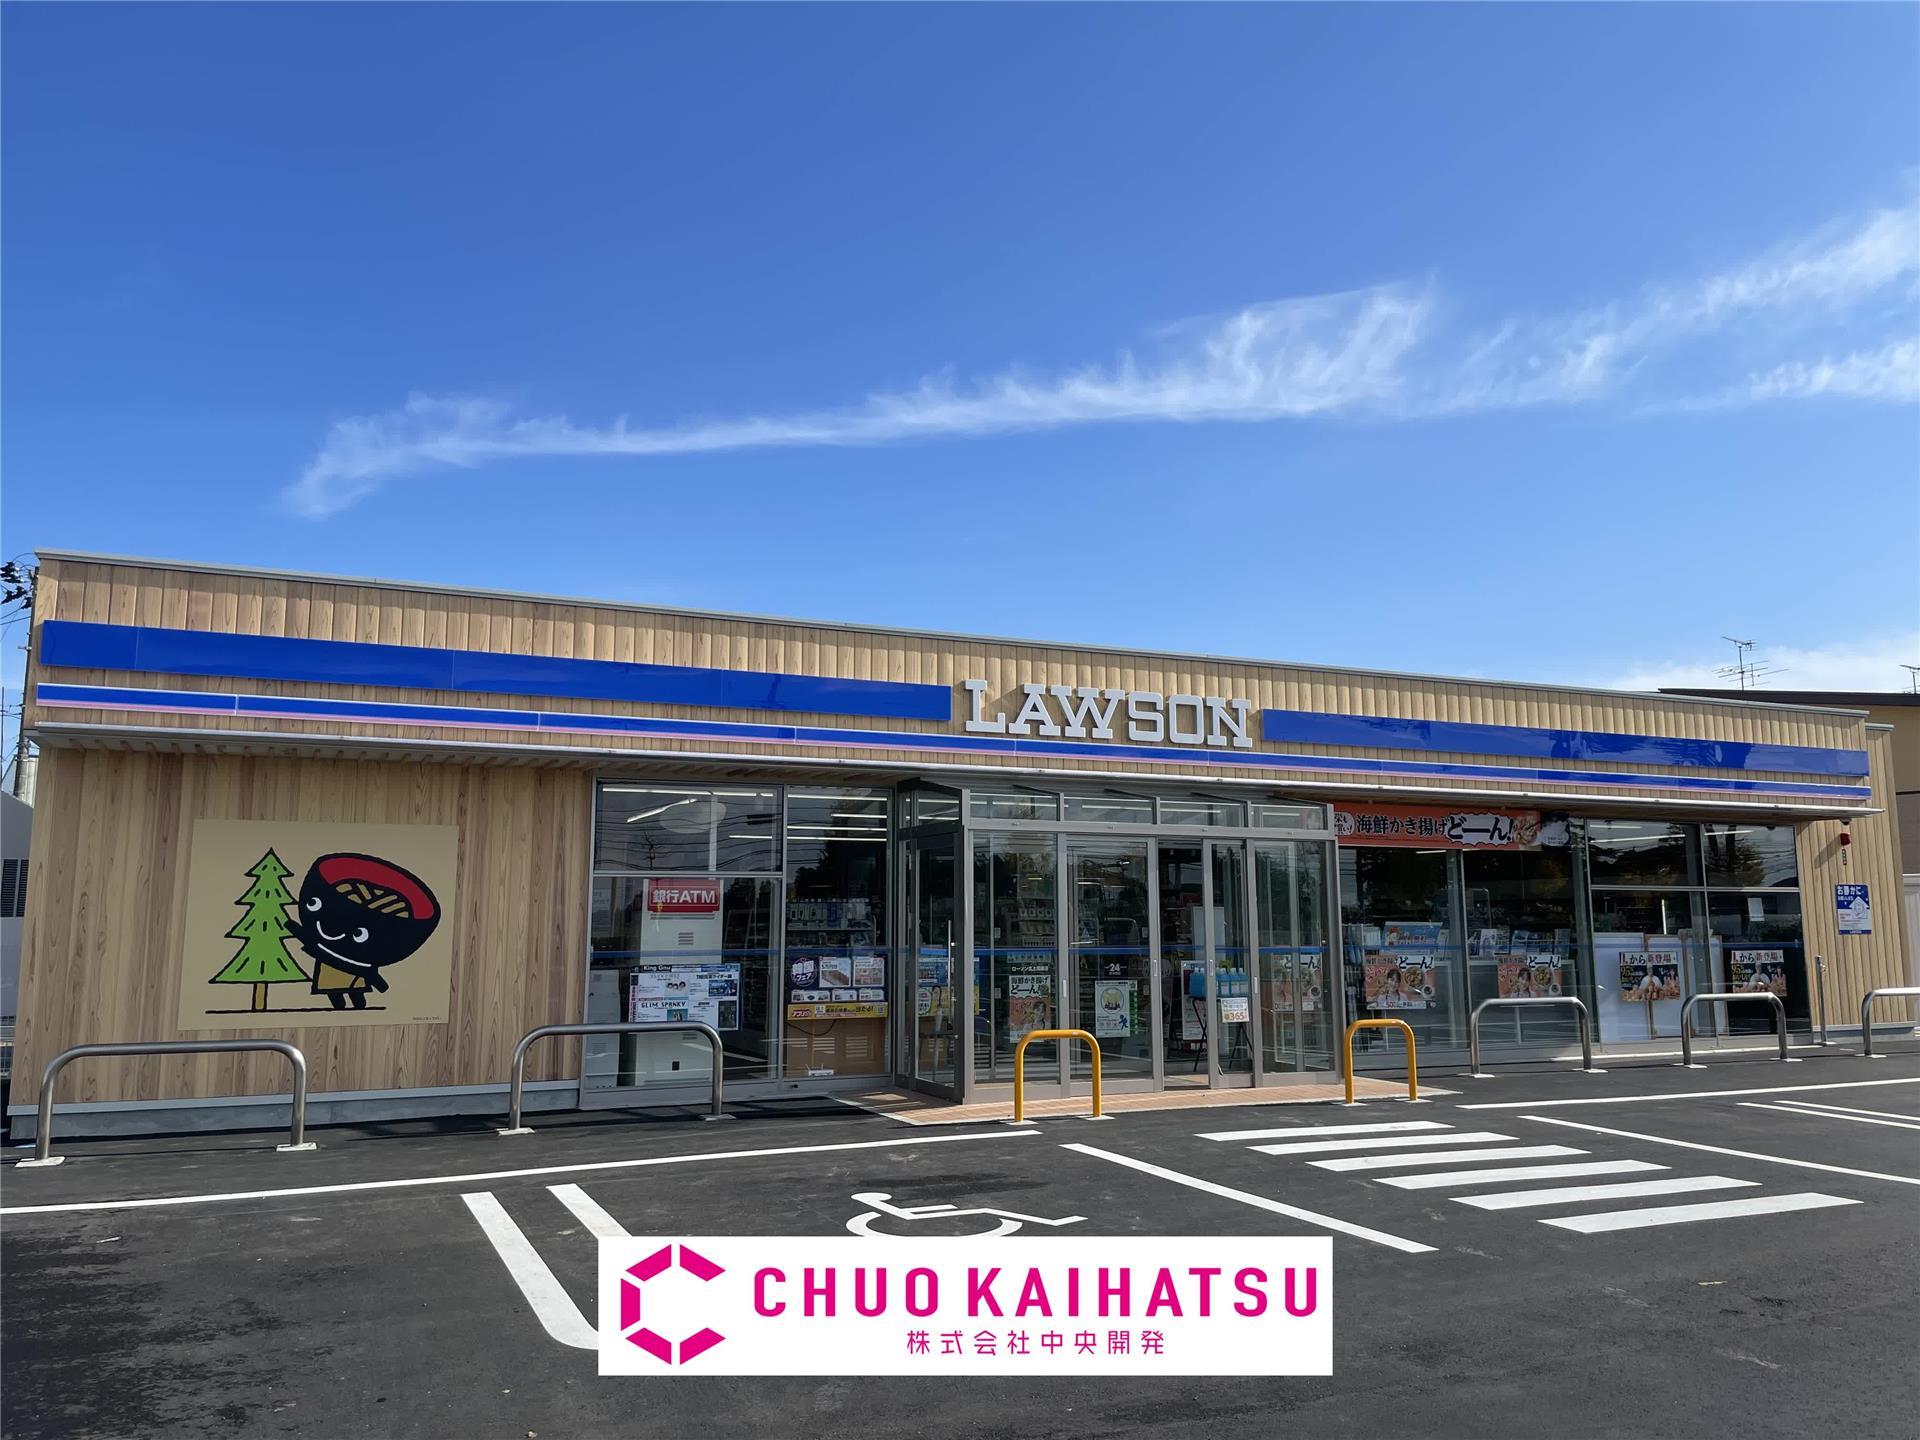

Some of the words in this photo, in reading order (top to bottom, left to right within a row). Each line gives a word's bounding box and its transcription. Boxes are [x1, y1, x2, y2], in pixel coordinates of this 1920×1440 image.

[965, 679, 1253, 748] LAWSON
[1357, 815, 1448, 836] 海鮮かき揚げ
[1447, 815, 1514, 842] どーん!
[652, 889, 716, 904] 銀行ATM
[1109, 963, 1121, 972] 24
[1230, 1012, 1245, 1021] 365
